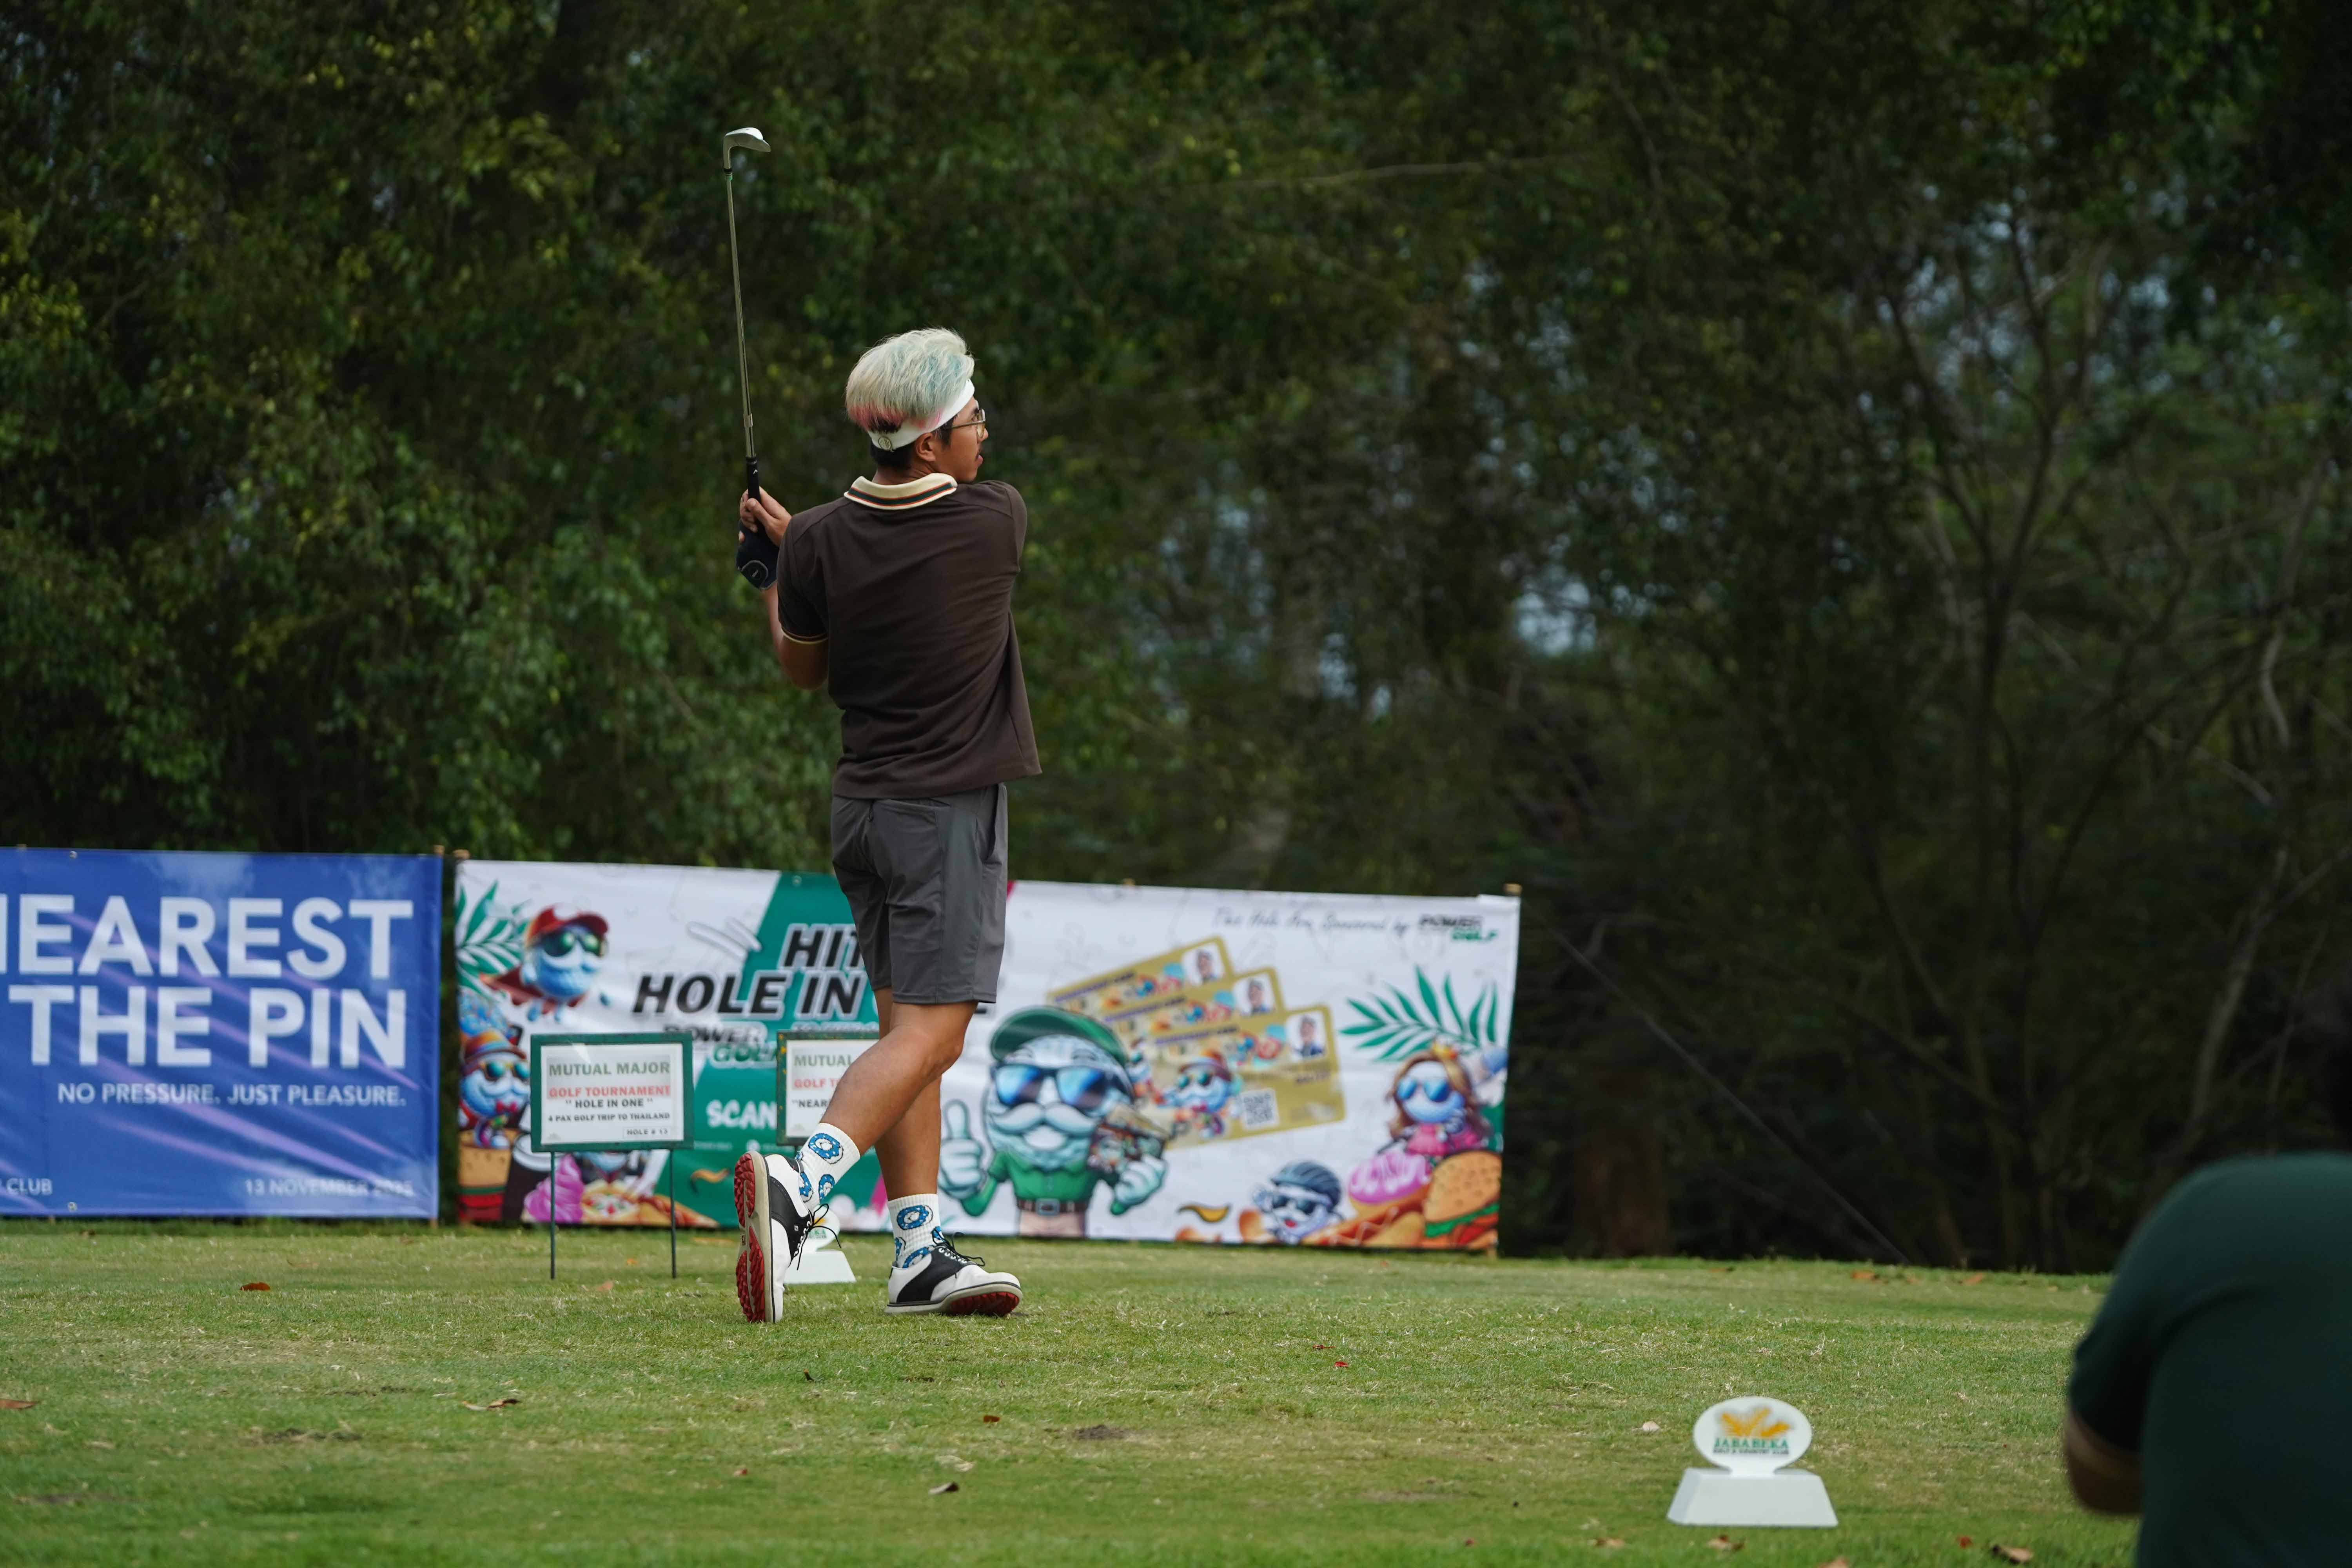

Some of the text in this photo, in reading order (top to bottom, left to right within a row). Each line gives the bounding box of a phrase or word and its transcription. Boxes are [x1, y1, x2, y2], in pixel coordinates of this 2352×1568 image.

[0, 893, 413, 980] EAREST
[633, 975, 862, 1014] HOLE IN
[9, 985, 406, 1069] THE PIN
[794, 1054, 851, 1067] MUTUAL
[549, 1062, 670, 1076] MUTUAL MAJOR
[794, 1078, 826, 1088] GOLF
[58, 1083, 407, 1107] NO PRESSURE. JUST PLEASURE.
[548, 1085, 671, 1098] GOLF TOURNAMENT
[575, 1099, 604, 1108] HOLE
[607, 1099, 618, 1107] IN
[621, 1098, 644, 1107] ONE
[630, 1112, 670, 1120] THAILAND
[706, 1099, 778, 1129] SCAN
[6, 1177, 53, 1196] CLUB
[244, 1178, 265, 1196] 13
[269, 1178, 368, 1197] NOVEMBER
[1713, 1437, 1789, 1449] JABABEKA
